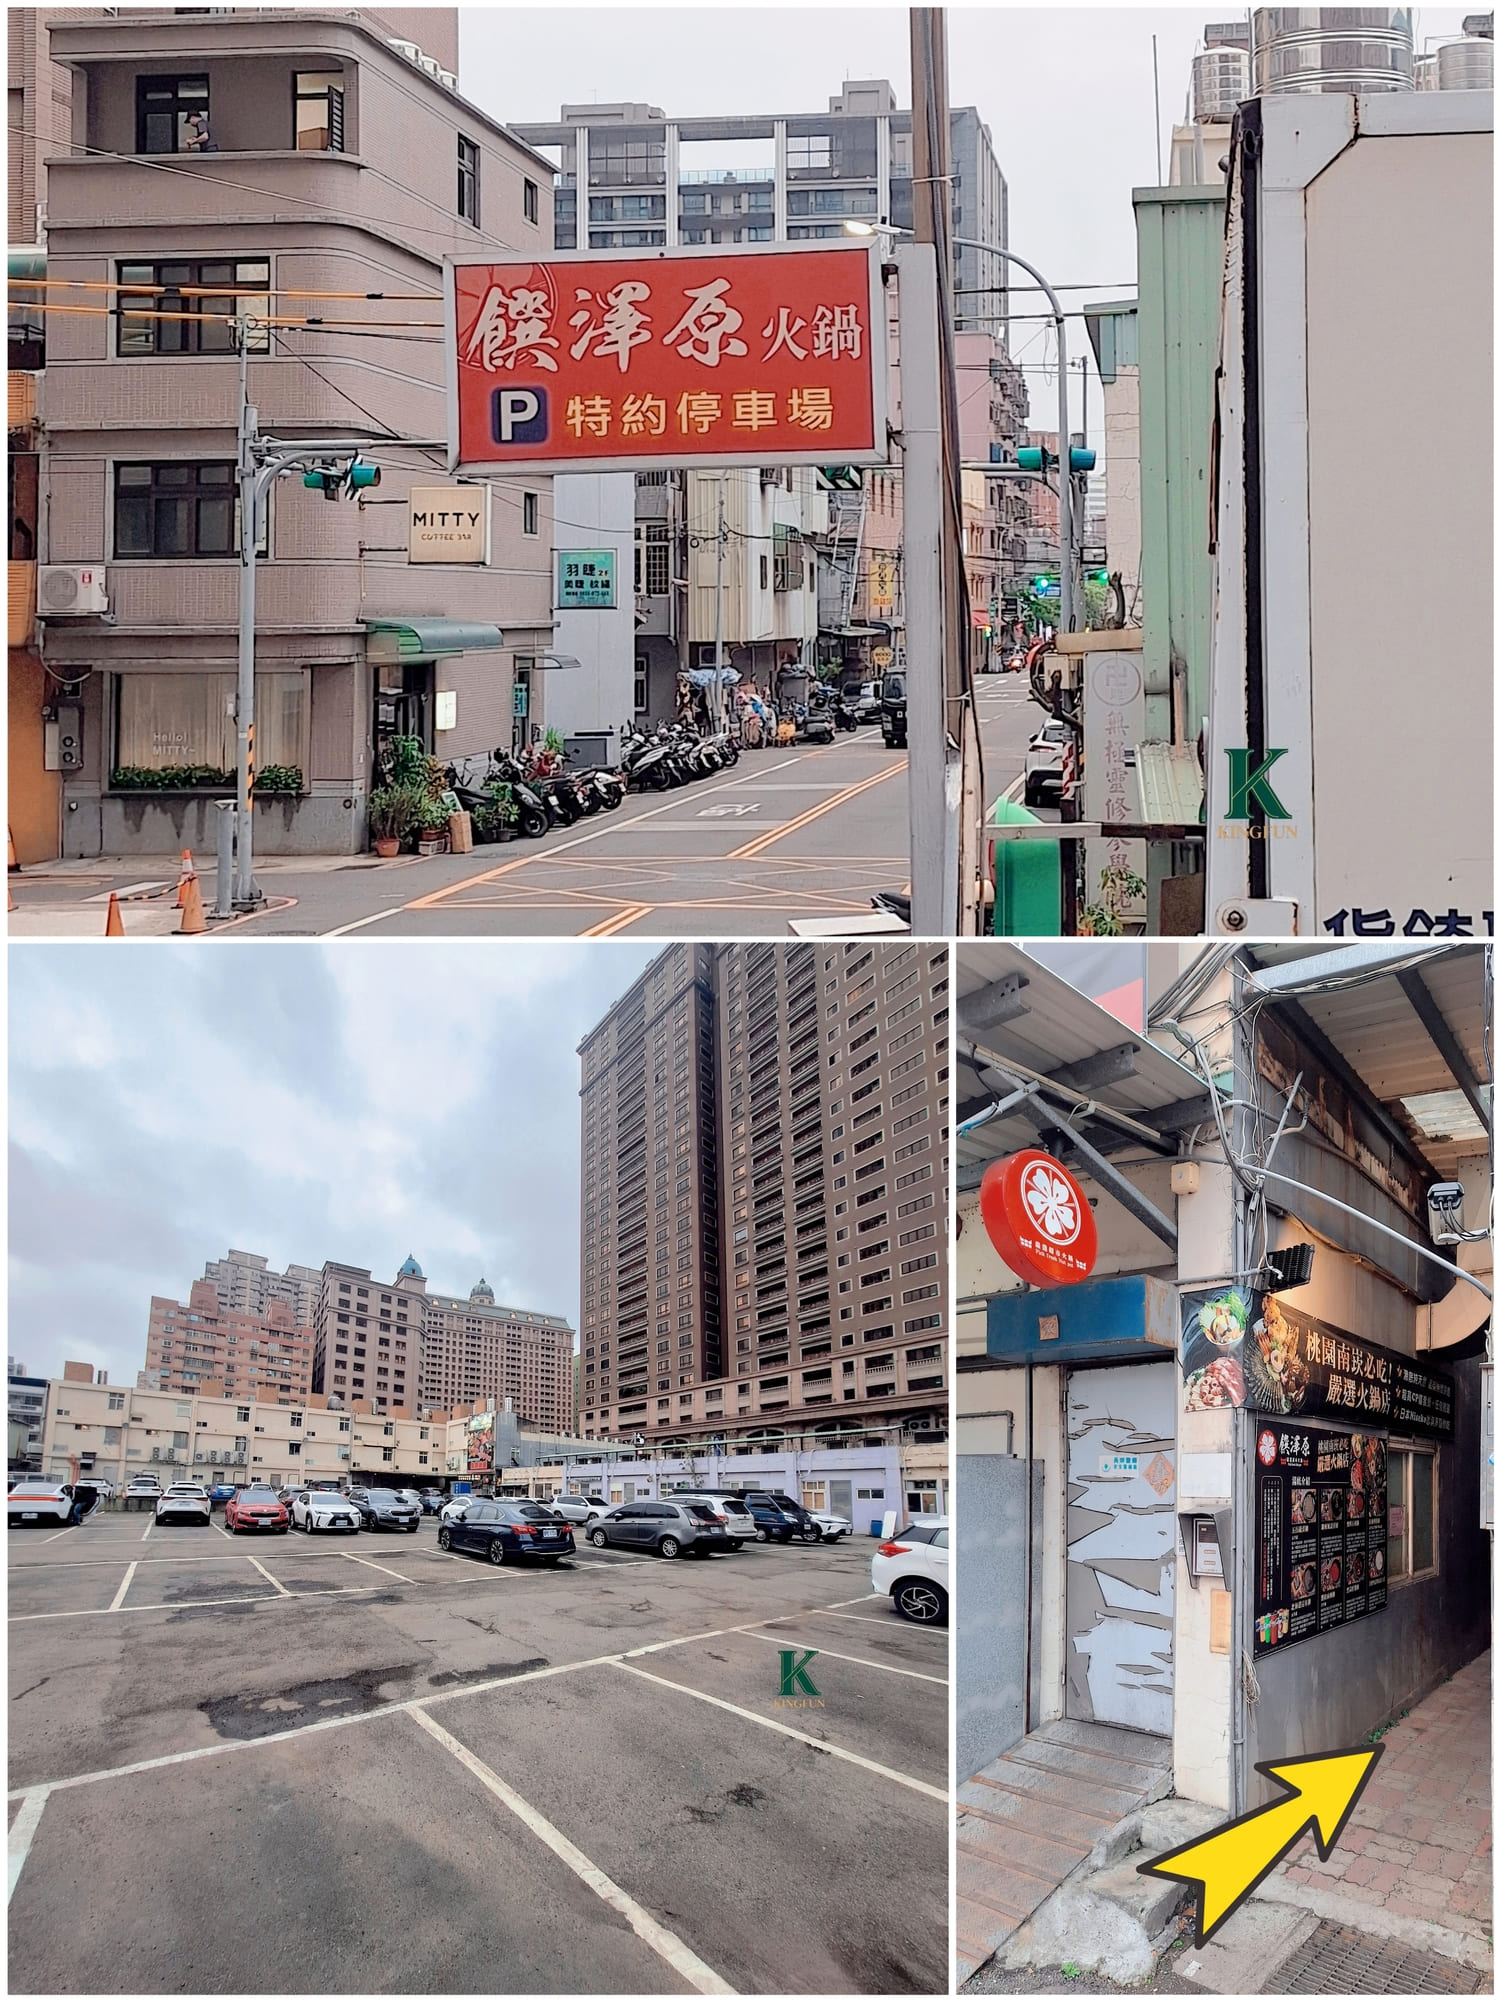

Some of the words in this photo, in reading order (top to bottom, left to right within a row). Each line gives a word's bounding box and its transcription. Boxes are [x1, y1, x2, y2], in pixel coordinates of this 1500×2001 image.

[761, 303, 863, 363] 火鍋
[500, 391, 539, 440] P
[565, 388, 834, 437] 特約停車場
[413, 512, 480, 527] MITTY
[1305, 1328, 1393, 1385] 桃園南崁必吃!
[1325, 1372, 1391, 1416] 嚴選火鍋店
